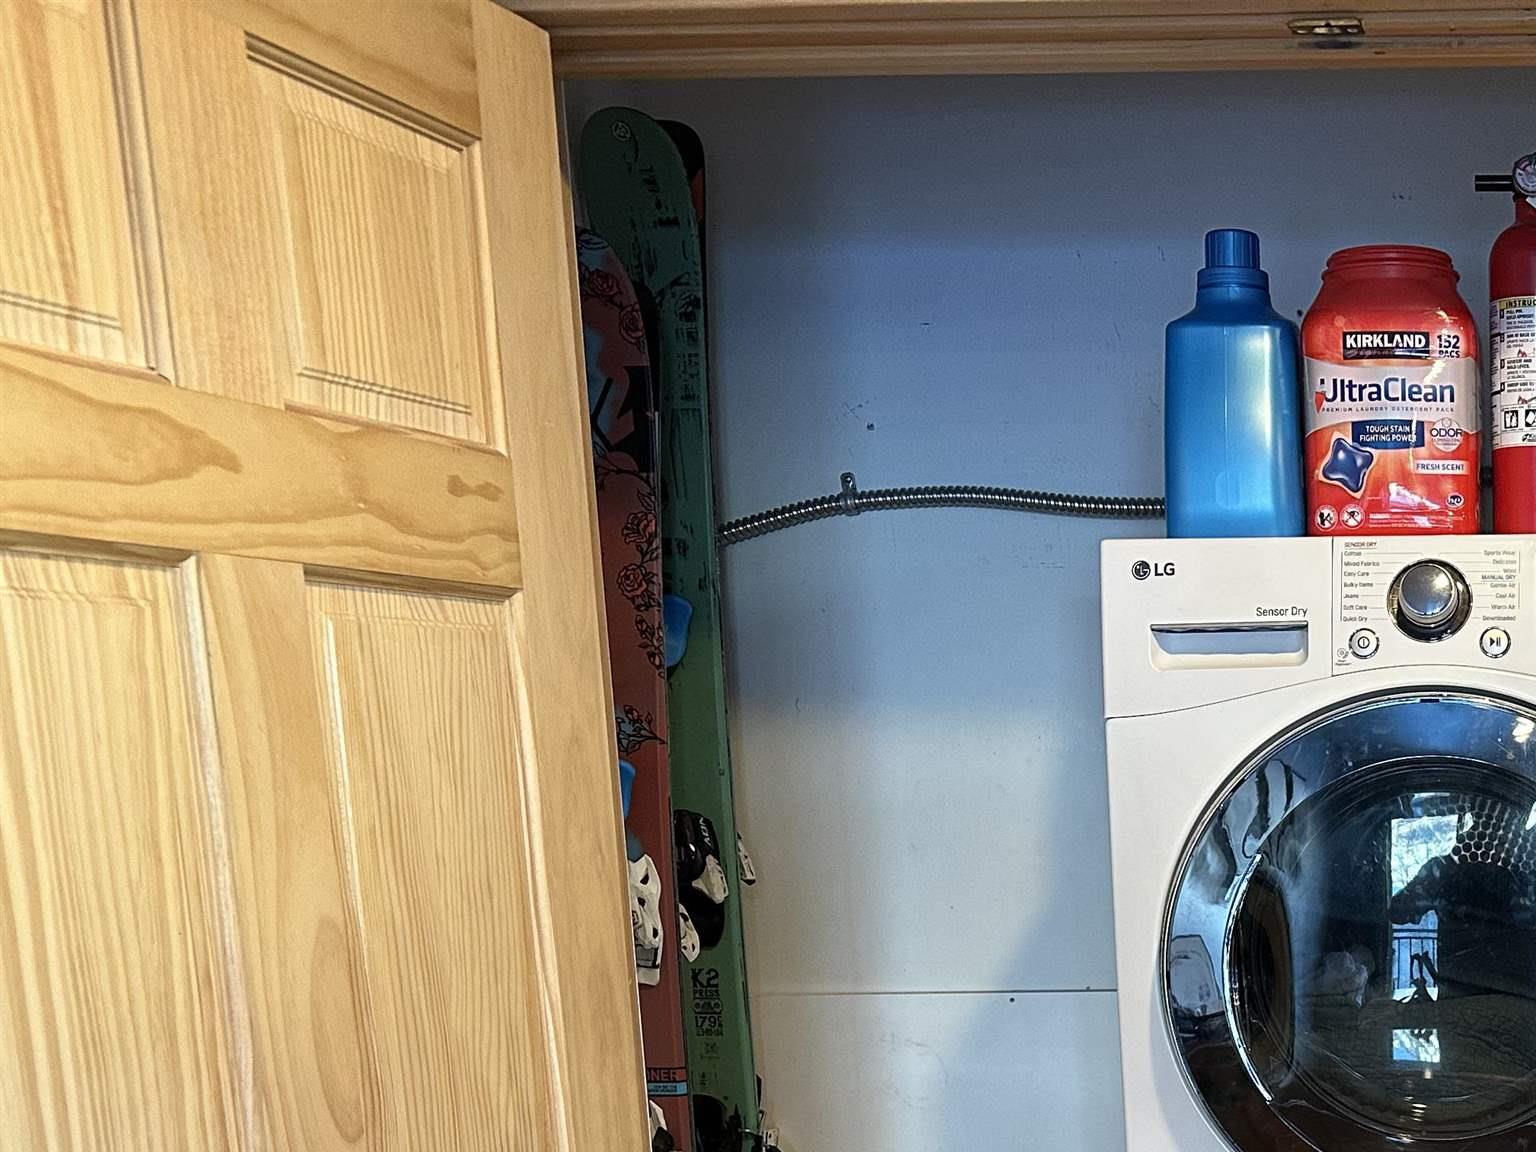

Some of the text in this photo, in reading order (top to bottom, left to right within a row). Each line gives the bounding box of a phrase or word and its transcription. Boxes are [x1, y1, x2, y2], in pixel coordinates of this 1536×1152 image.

[1346, 334, 1426, 348] KIRKLAND
[1437, 334, 1460, 349] 152
[1438, 350, 1460, 359] PACS
[1320, 377, 1455, 403] UltraClean
[1365, 425, 1410, 433] TOUGH STAIN
[1430, 428, 1464, 437] ODOR
[1360, 434, 1391, 442] FIGHTING
[1416, 463, 1464, 471] FRESH SCENT
[1154, 562, 1175, 577] LG
[1256, 606, 1308, 619] Sensor Dry
[691, 967, 719, 988] K2
[692, 989, 721, 997] PRESS
